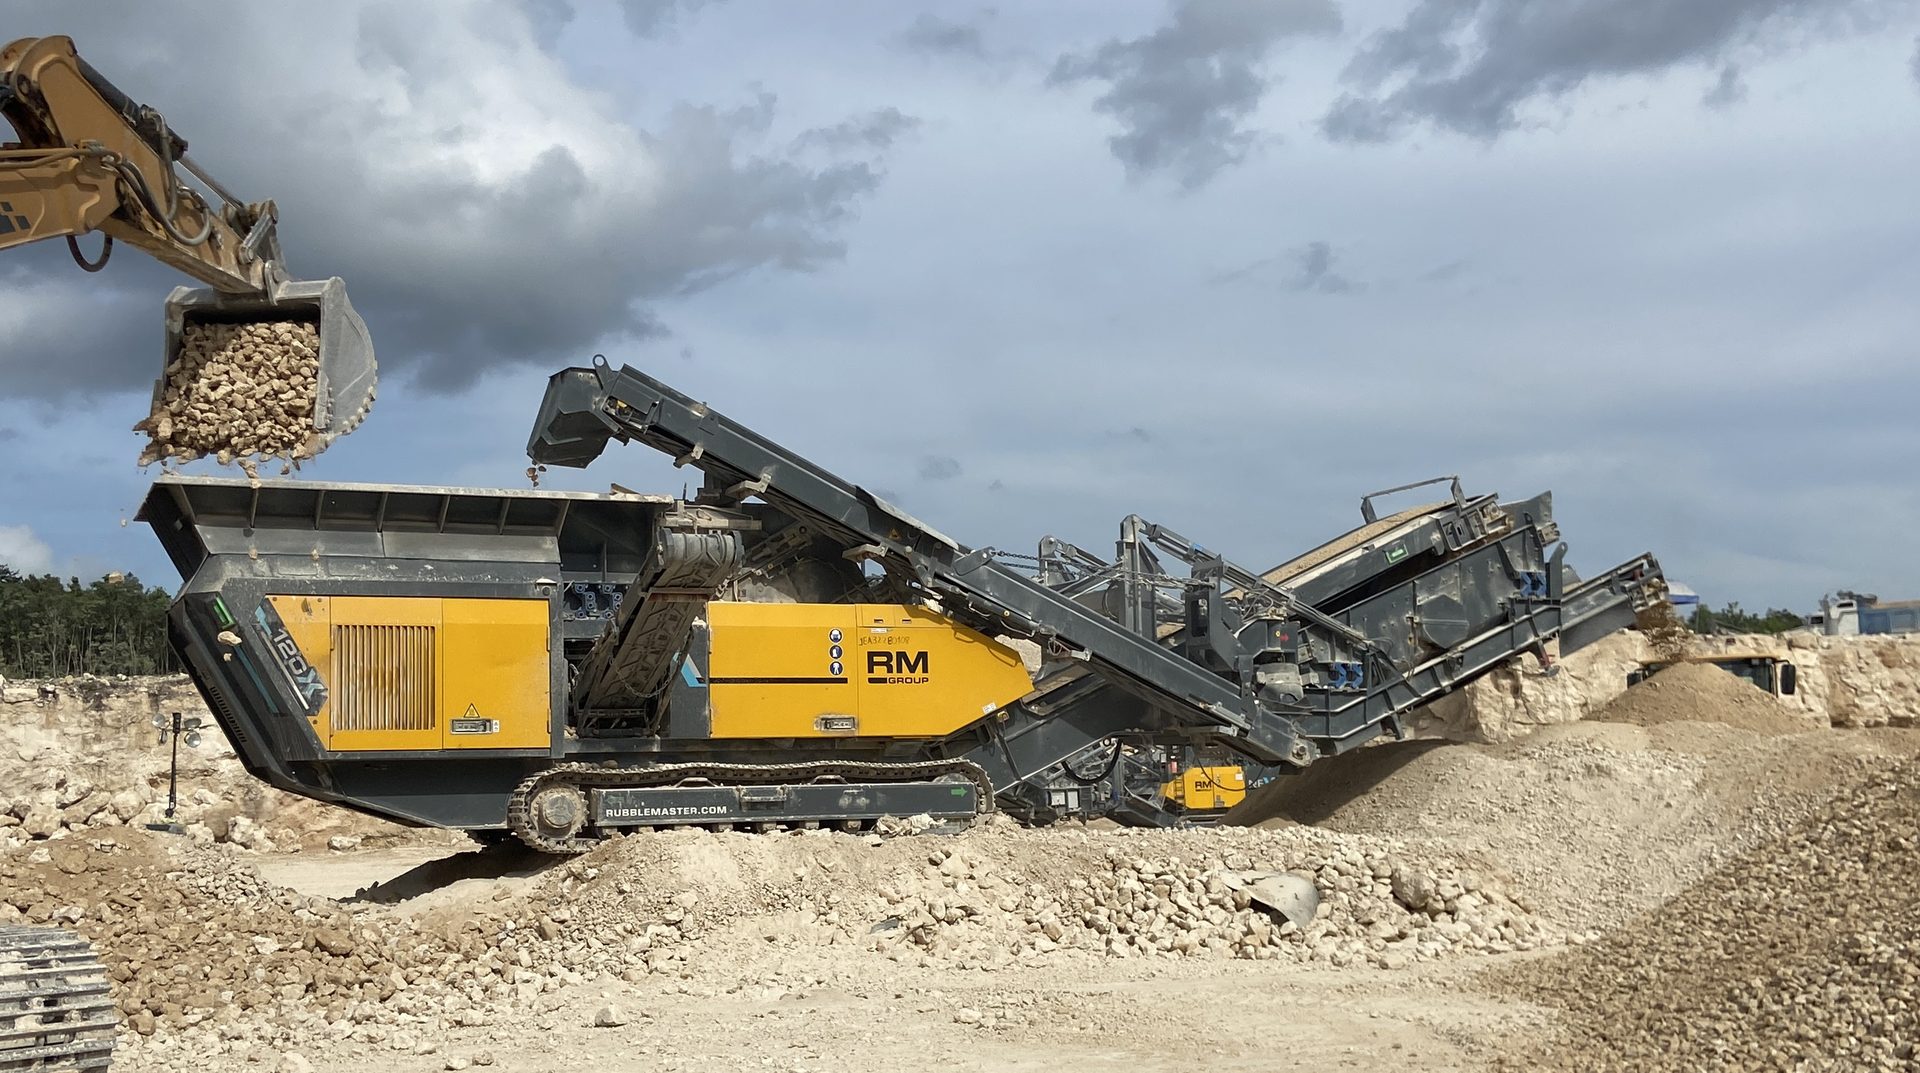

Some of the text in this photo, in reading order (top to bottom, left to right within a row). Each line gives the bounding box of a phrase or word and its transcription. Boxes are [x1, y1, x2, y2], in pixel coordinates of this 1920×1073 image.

[273, 628, 325, 699] 120X
[867, 651, 929, 674] RM
[1195, 781, 1212, 789] RM
[606, 806, 727, 817] RUBBLEMASTER.COM
